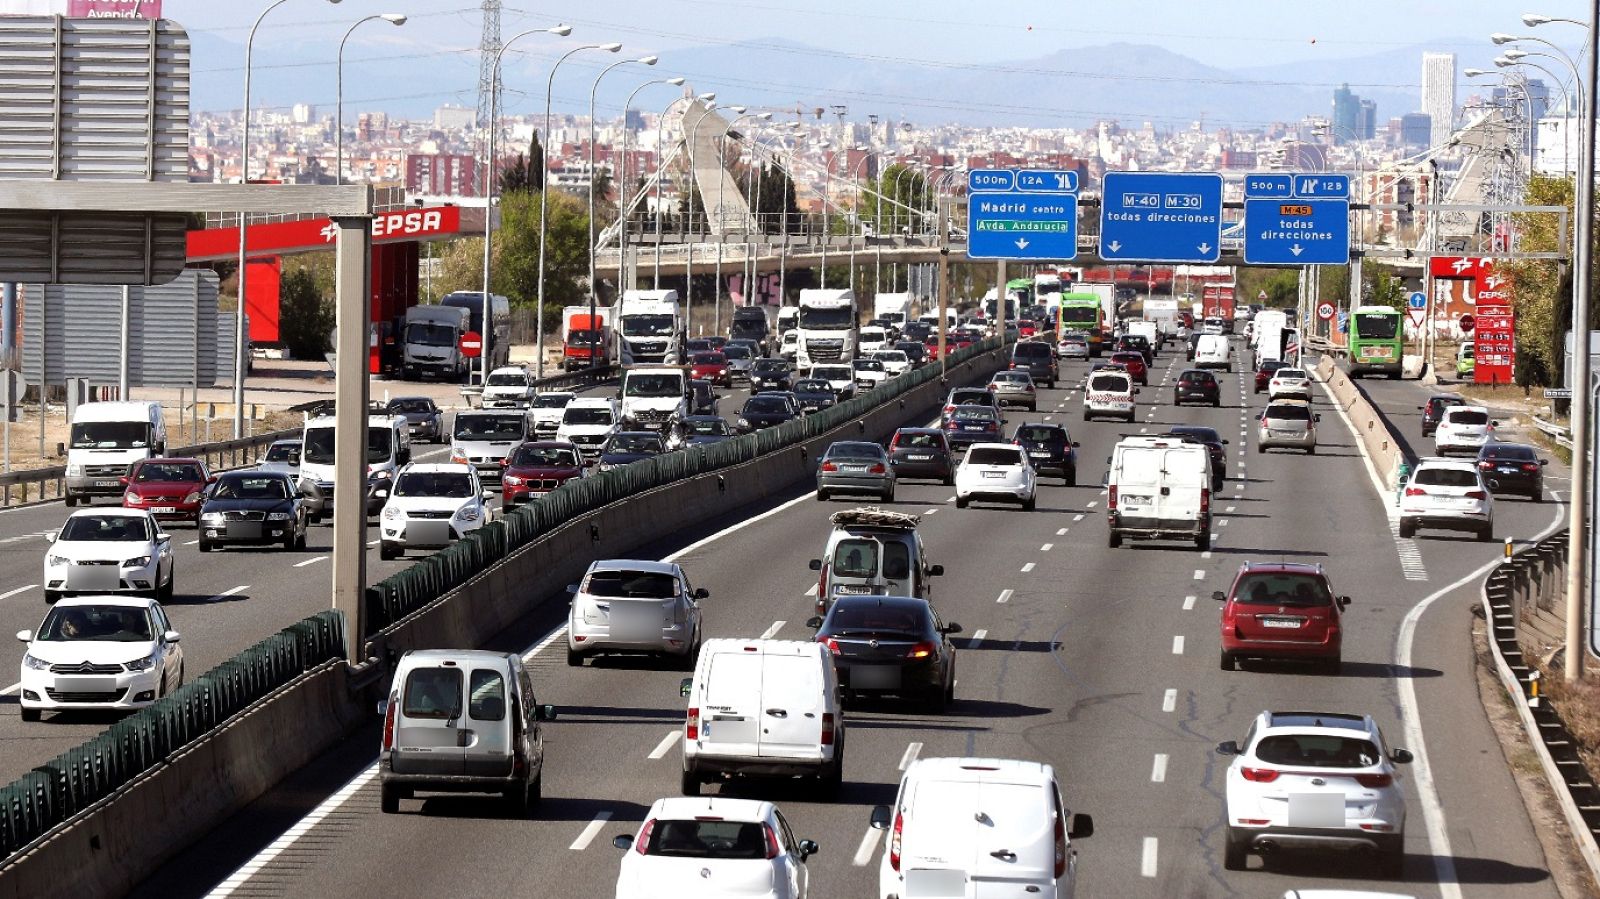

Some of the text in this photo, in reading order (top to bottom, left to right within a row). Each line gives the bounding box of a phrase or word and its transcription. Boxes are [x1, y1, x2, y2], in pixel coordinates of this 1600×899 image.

[87, 9, 143, 18] Avenida
[975, 176, 1008, 185] 500m
[1022, 176, 1043, 185] 12A
[1251, 182, 1273, 190] 500
[1322, 182, 1342, 190] 12B
[1125, 196, 1157, 206] M-40
[1167, 197, 1199, 207] M-30
[980, 202, 1064, 213] Madrid centro
[1284, 206, 1308, 214] M-45
[1107, 212, 1215, 223] todas direcciones
[371, 211, 442, 236] EPSA
[978, 221, 1007, 230] Avda.
[1279, 219, 1314, 229] todas
[1261, 230, 1333, 240] direcciones
[1320, 305, 1332, 315] 100
